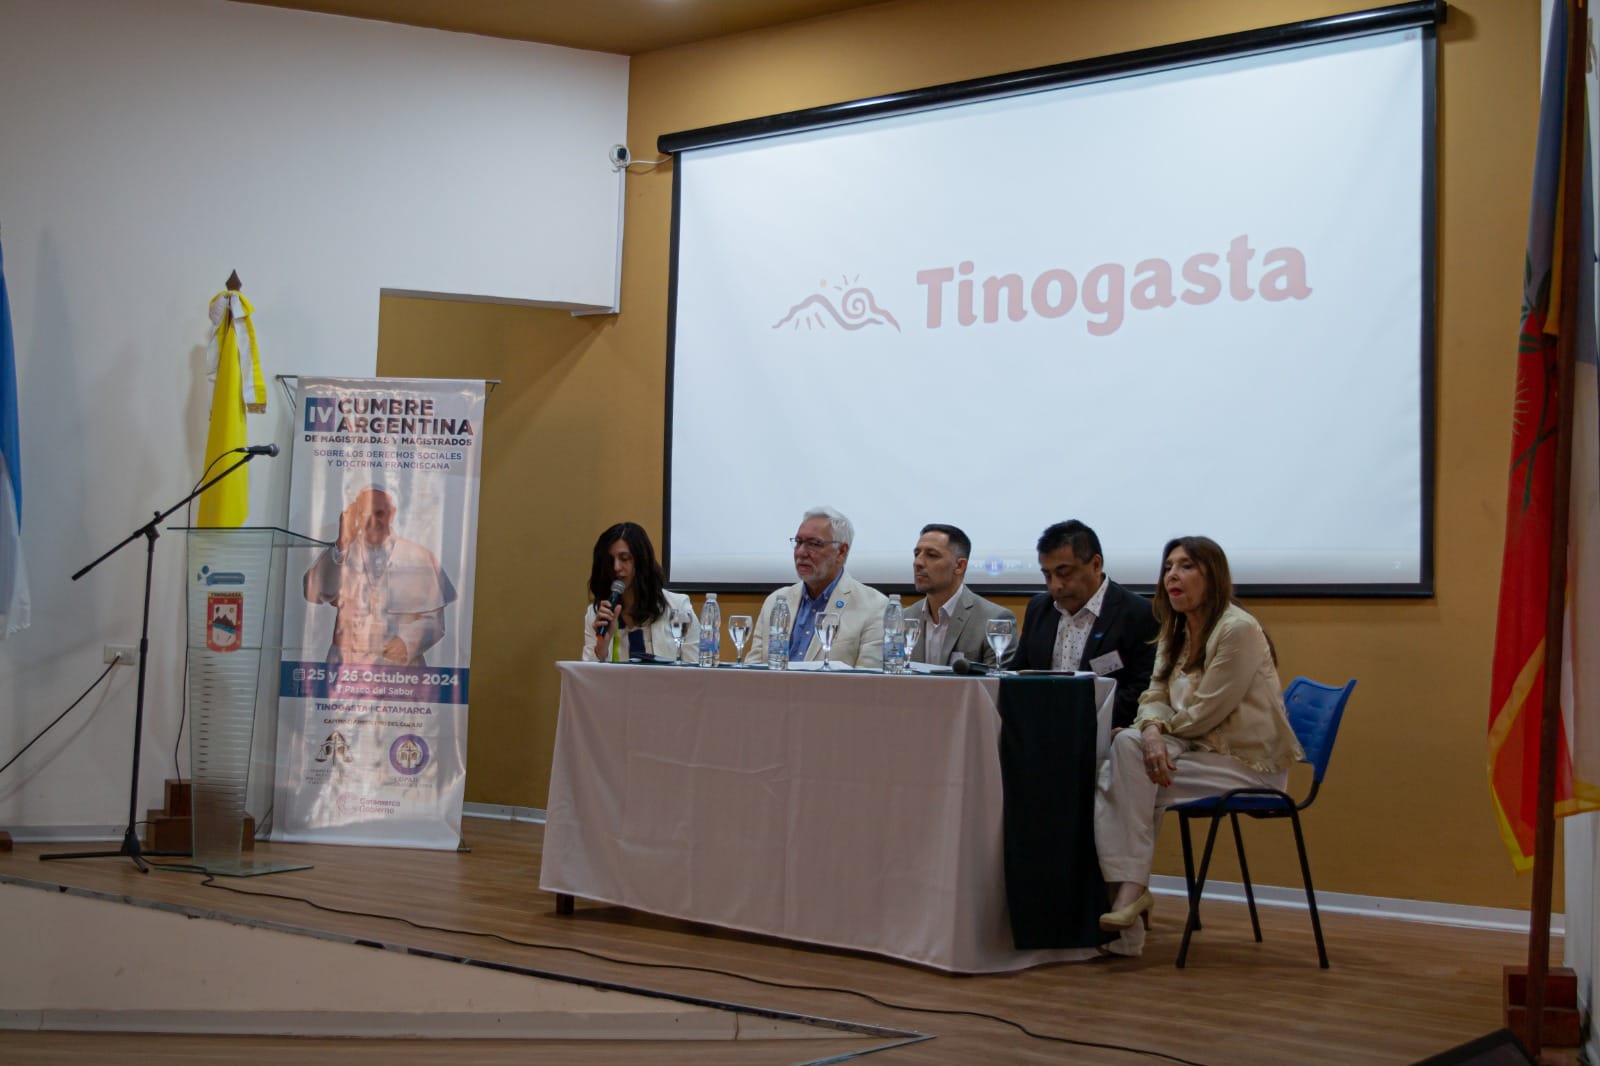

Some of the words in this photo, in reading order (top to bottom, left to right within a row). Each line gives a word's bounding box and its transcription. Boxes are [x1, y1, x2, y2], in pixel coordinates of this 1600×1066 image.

[916, 234, 1313, 337] Tinogasta
[338, 398, 434, 416] CUMBRE
[309, 406, 334, 423] IV
[336, 417, 474, 436] ARGENTINA
[304, 434, 317, 443] DE
[320, 435, 389, 444] MAGISTRADAS
[402, 438, 472, 446] MAGISTRADOS
[313, 449, 344, 457] SOBRE
[346, 450, 364, 458] LOS
[367, 451, 415, 459] DERECHOS
[418, 452, 462, 460] SOCIALES
[327, 459, 333, 467] Y
[336, 460, 382, 468] DOCTRINA
[385, 461, 450, 469] FRANCISCANA
[307, 669, 325, 681] 25
[328, 671, 338, 683] y
[340, 670, 359, 682] 26
[362, 671, 419, 684] Octubre
[422, 673, 459, 686] 2024
[389, 686, 414, 696] Sabor
[374, 704, 432, 715] CATAMARCA
